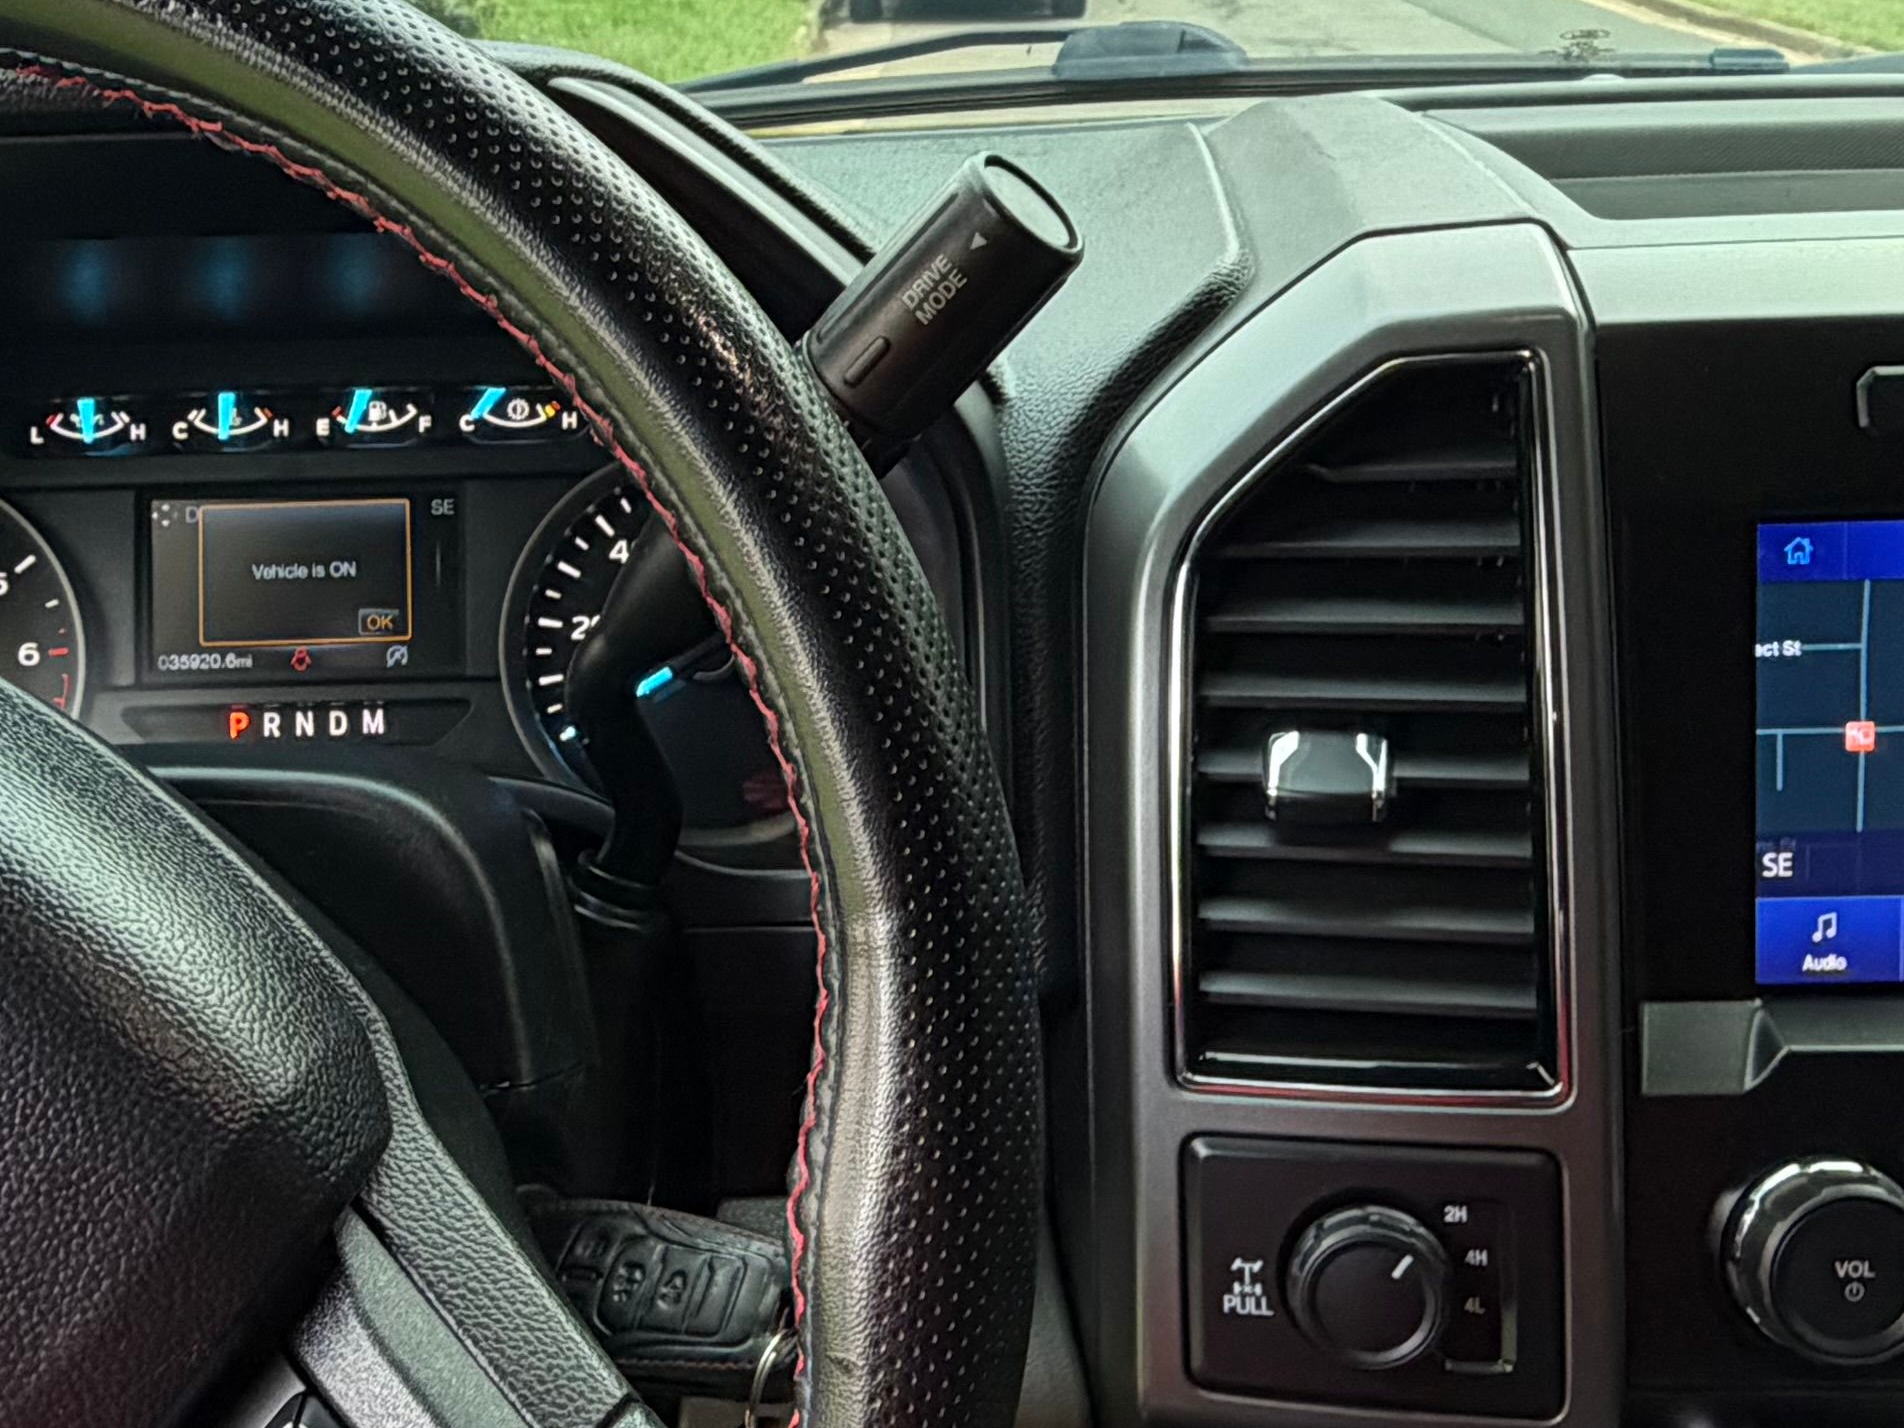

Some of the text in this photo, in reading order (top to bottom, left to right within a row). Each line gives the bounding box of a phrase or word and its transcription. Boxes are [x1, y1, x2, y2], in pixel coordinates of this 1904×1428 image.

[902, 254, 952, 309] DRIVE
[915, 268, 967, 325] MODE
[273, 419, 289, 437] H
[315, 418, 330, 436] E
[418, 415, 432, 433] F
[459, 414, 475, 432] C
[562, 411, 577, 430] H
[30, 427, 45, 444] L
[130, 423, 146, 441] H
[172, 421, 189, 440] C
[431, 499, 454, 516] SE
[252, 560, 357, 581] Vehicle is ON
[366, 614, 394, 632] OK
[17, 642, 40, 667] 6
[228, 708, 385, 739] P R N D M
[1761, 852, 1794, 878] SE
[1802, 953, 1848, 972] Audio
[1443, 1205, 1468, 1223] 2H
[1464, 1249, 1488, 1267] 4H
[1834, 1259, 1876, 1279] VOL
[1222, 1293, 1275, 1317] PULL
[1464, 1297, 1486, 1314] 4L
